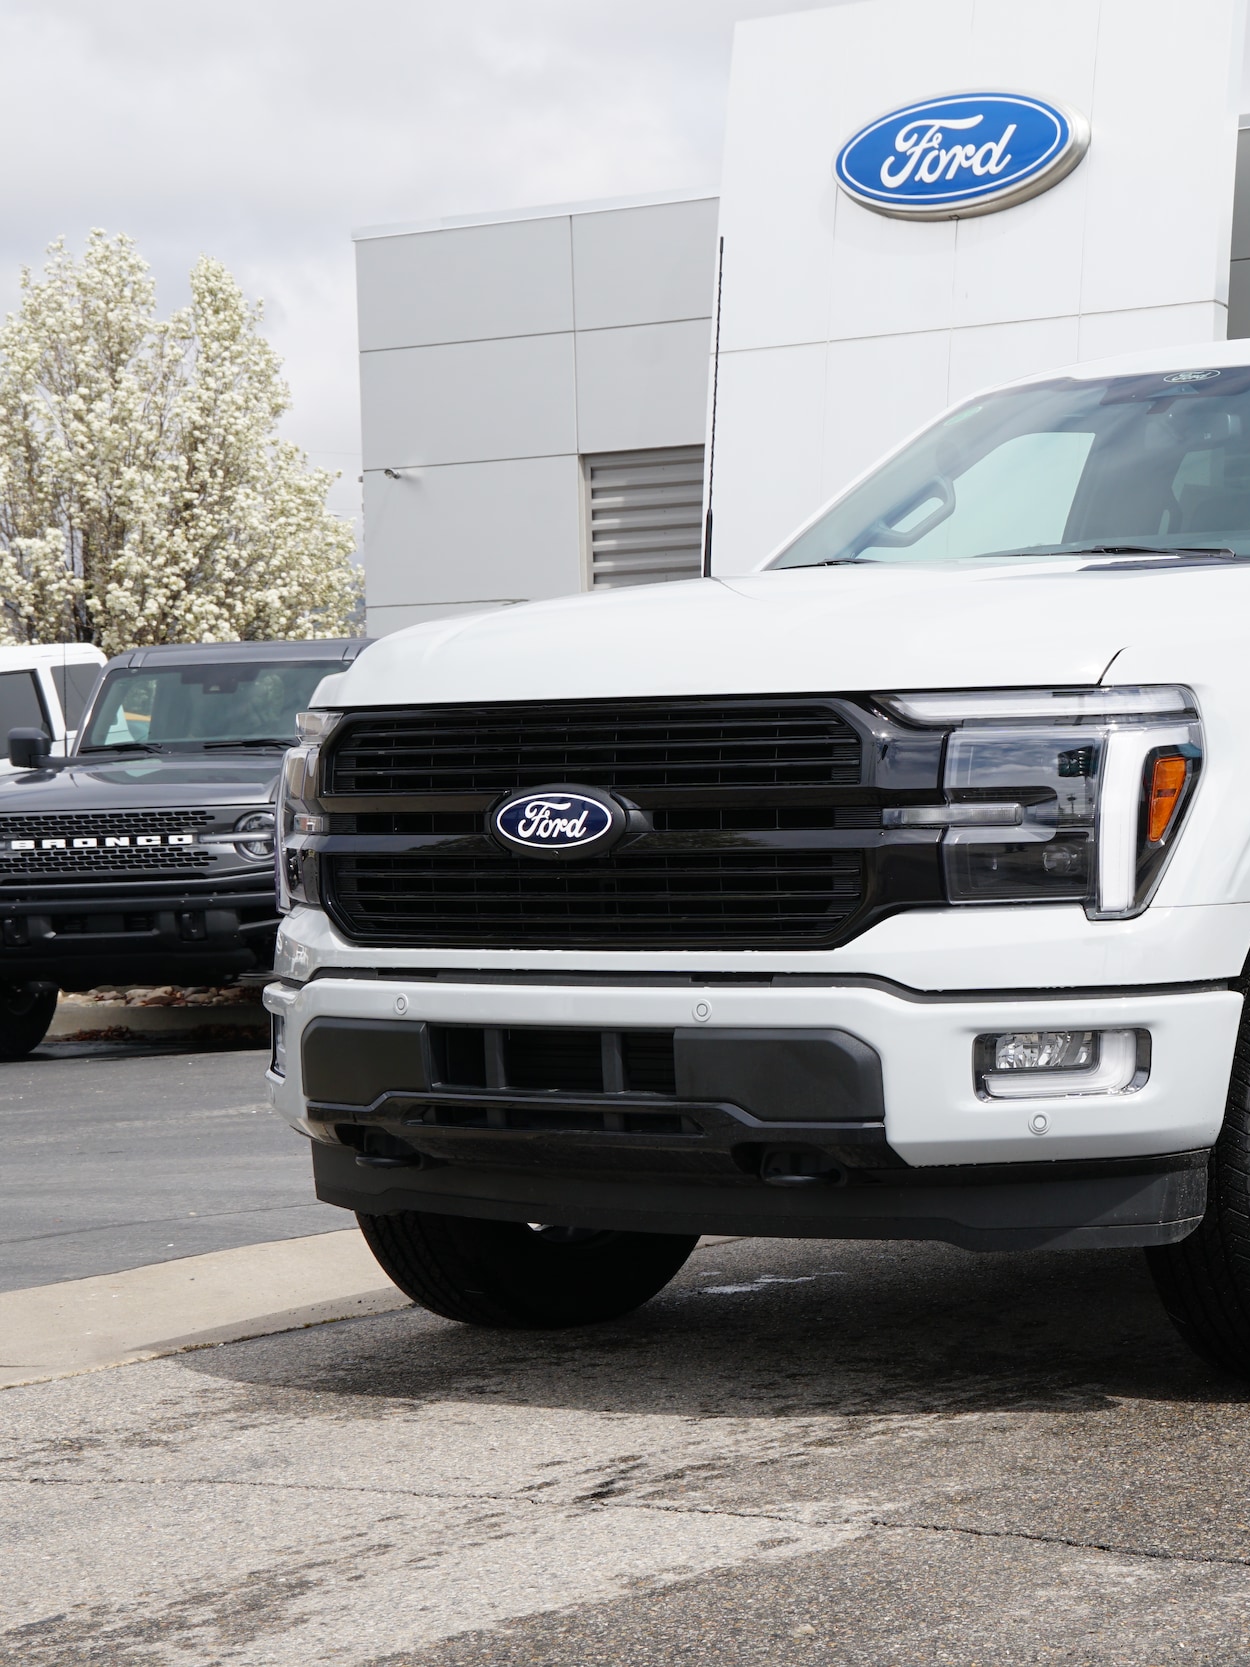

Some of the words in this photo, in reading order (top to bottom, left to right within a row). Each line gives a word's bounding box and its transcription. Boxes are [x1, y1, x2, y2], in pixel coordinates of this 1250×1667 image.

[880, 113, 1017, 188] Ford
[517, 801, 589, 838] Ford
[11, 834, 193, 850] BRONCO
